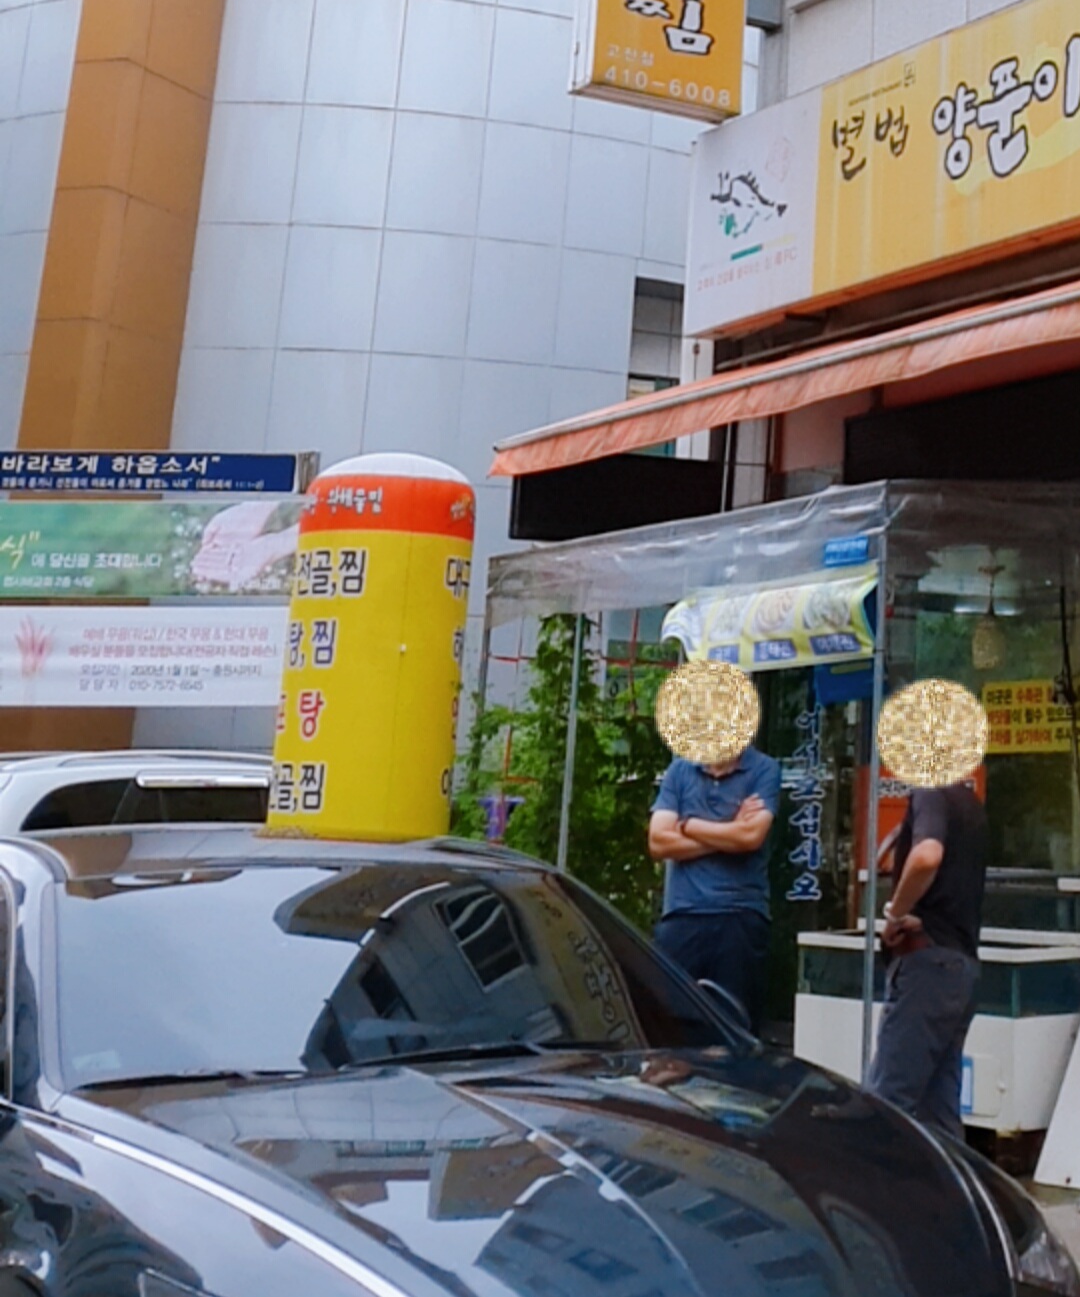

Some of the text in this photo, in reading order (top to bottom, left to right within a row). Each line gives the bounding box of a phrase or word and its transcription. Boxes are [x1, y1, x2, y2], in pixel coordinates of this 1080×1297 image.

[1, 454, 99, 474] 바라보게
[49, 552, 91, 569] 당신을
[94, 552, 163, 569] 초대합니다
